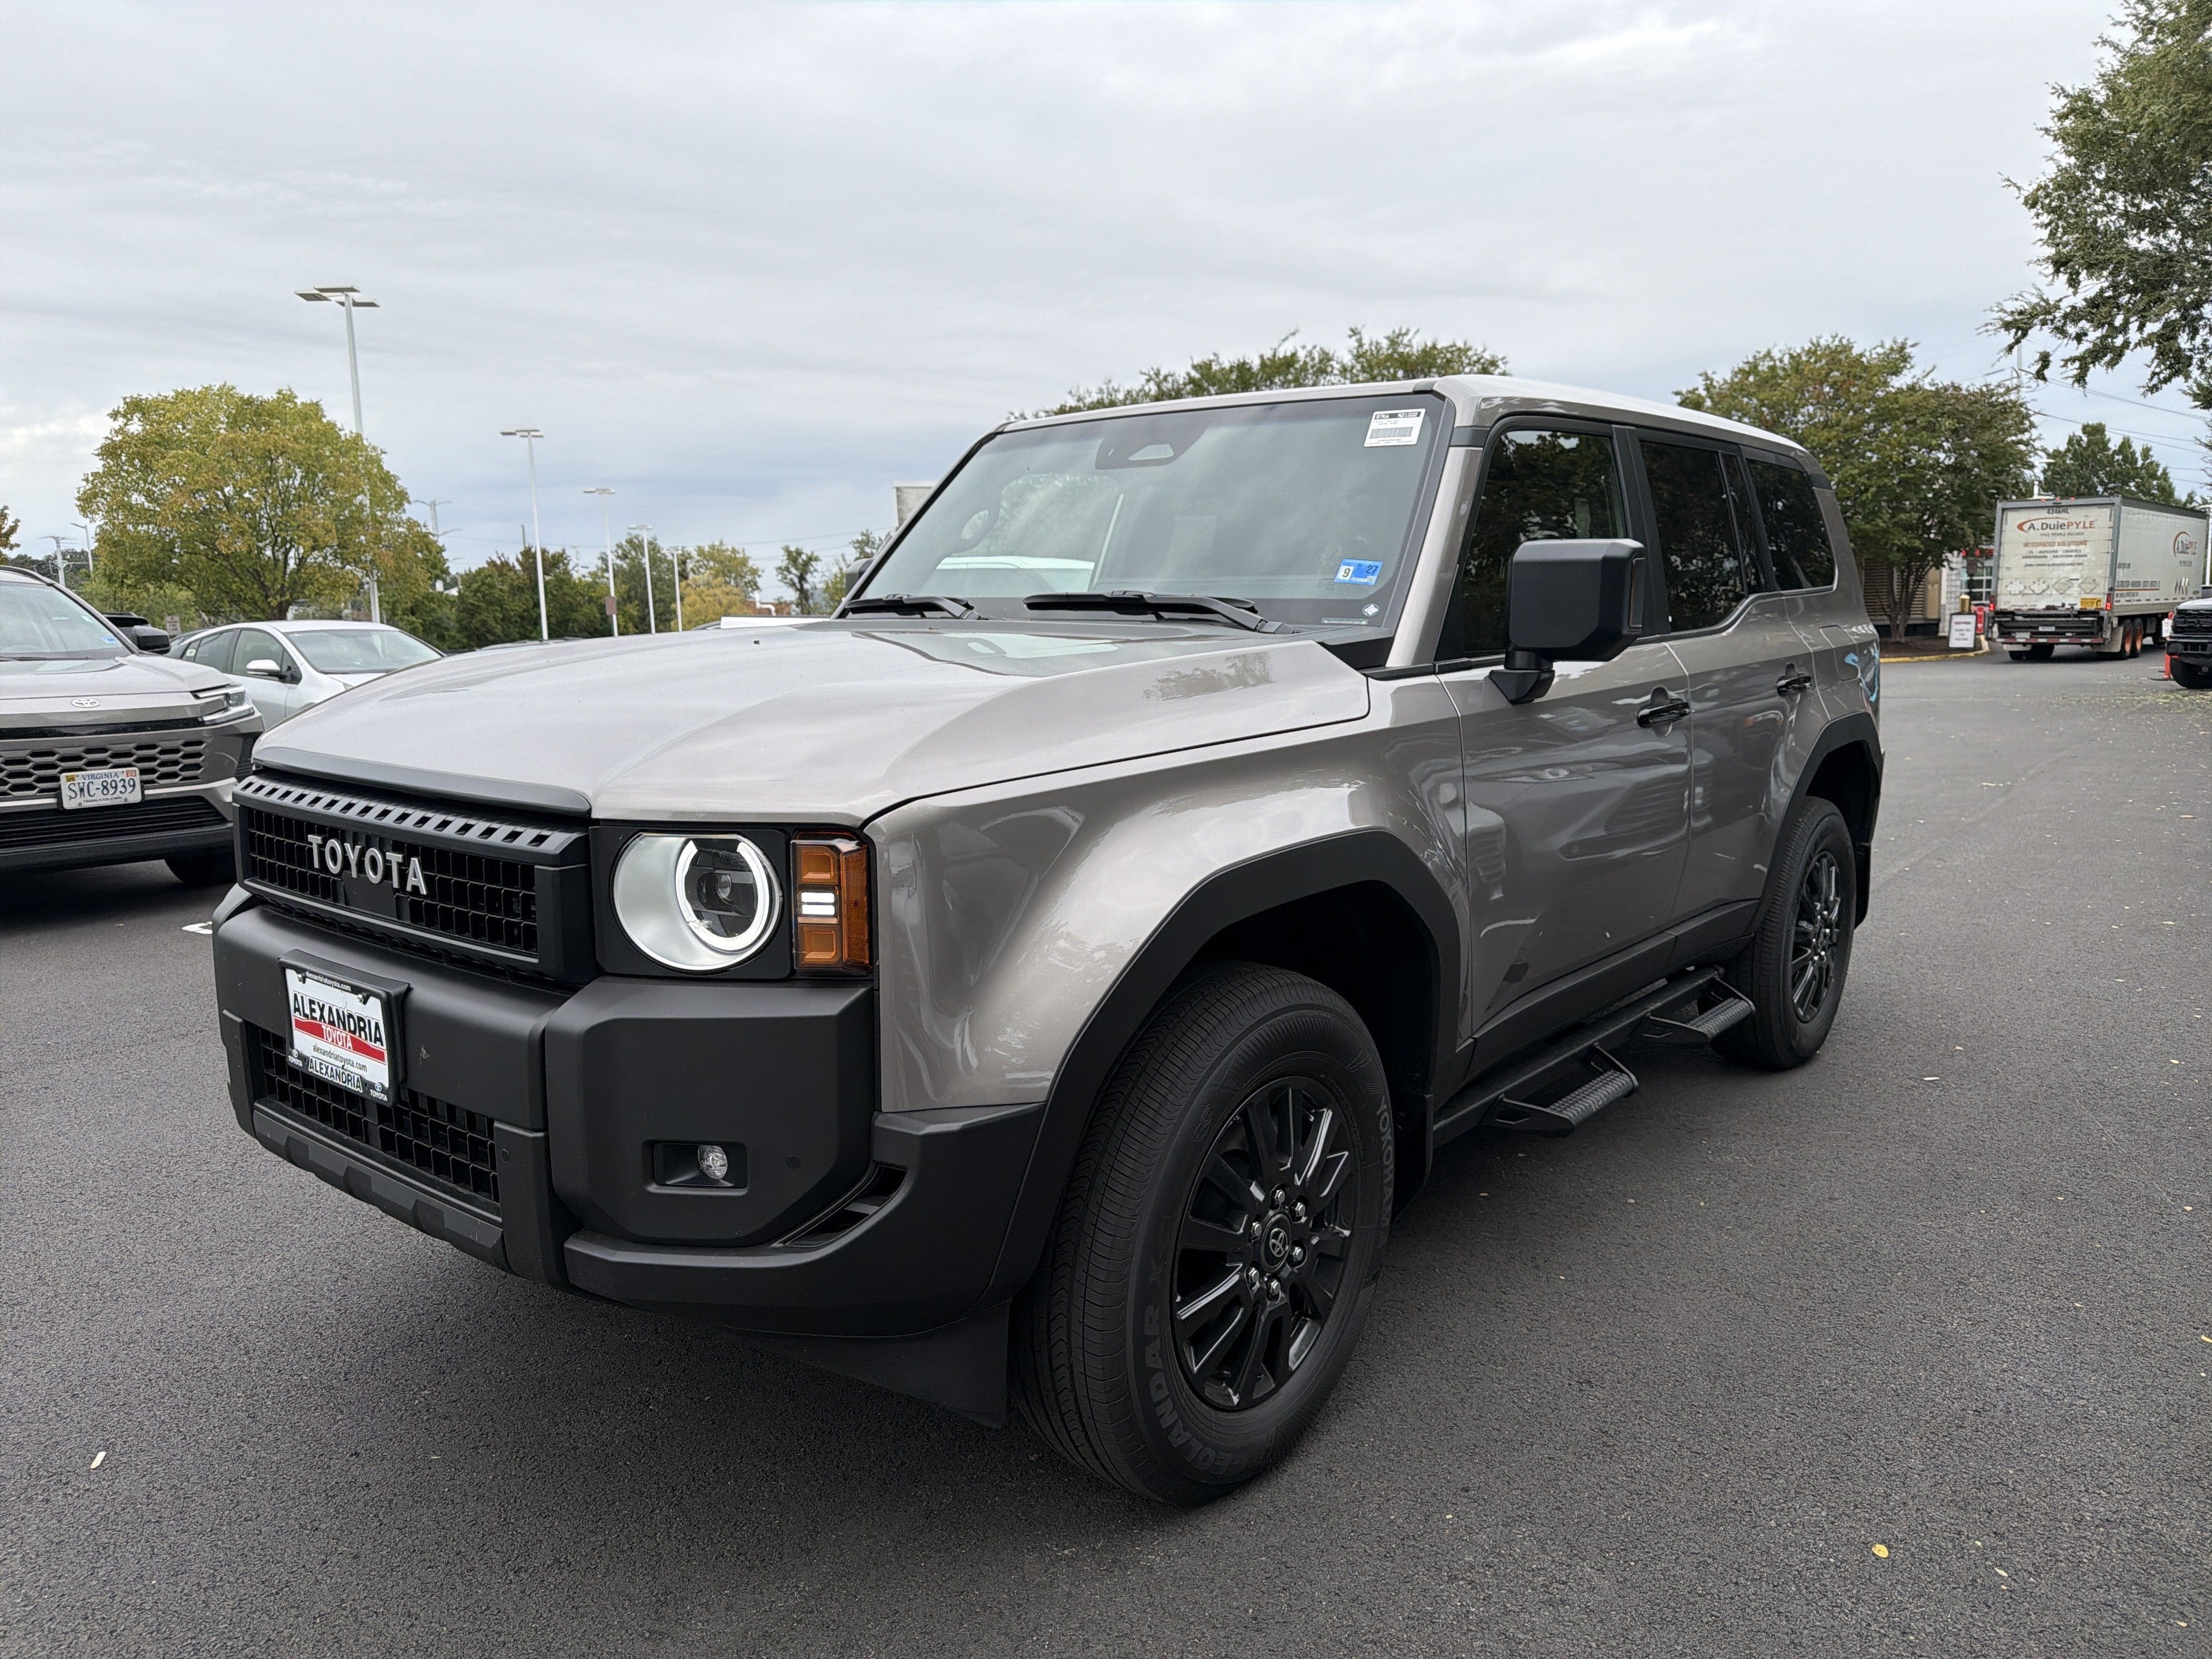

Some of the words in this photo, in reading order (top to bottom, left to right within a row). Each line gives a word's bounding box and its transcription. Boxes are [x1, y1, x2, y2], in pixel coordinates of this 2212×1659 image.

[1342, 568, 1351, 578] 9
[1365, 565, 1379, 575] 27
[82, 772, 120, 781] VIRGINIA
[67, 777, 136, 801] SWC-8939
[307, 834, 428, 895] TOYOTA
[292, 992, 385, 1047] ALEXANDRIA
[321, 1024, 353, 1050] TOYOTA
[288, 1054, 303, 1068] TOYOTA
[312, 1043, 368, 1073] alexandriatoyota.com
[308, 1058, 363, 1093] ALEXANDRIA
[370, 1088, 388, 1102] TOYOTA
